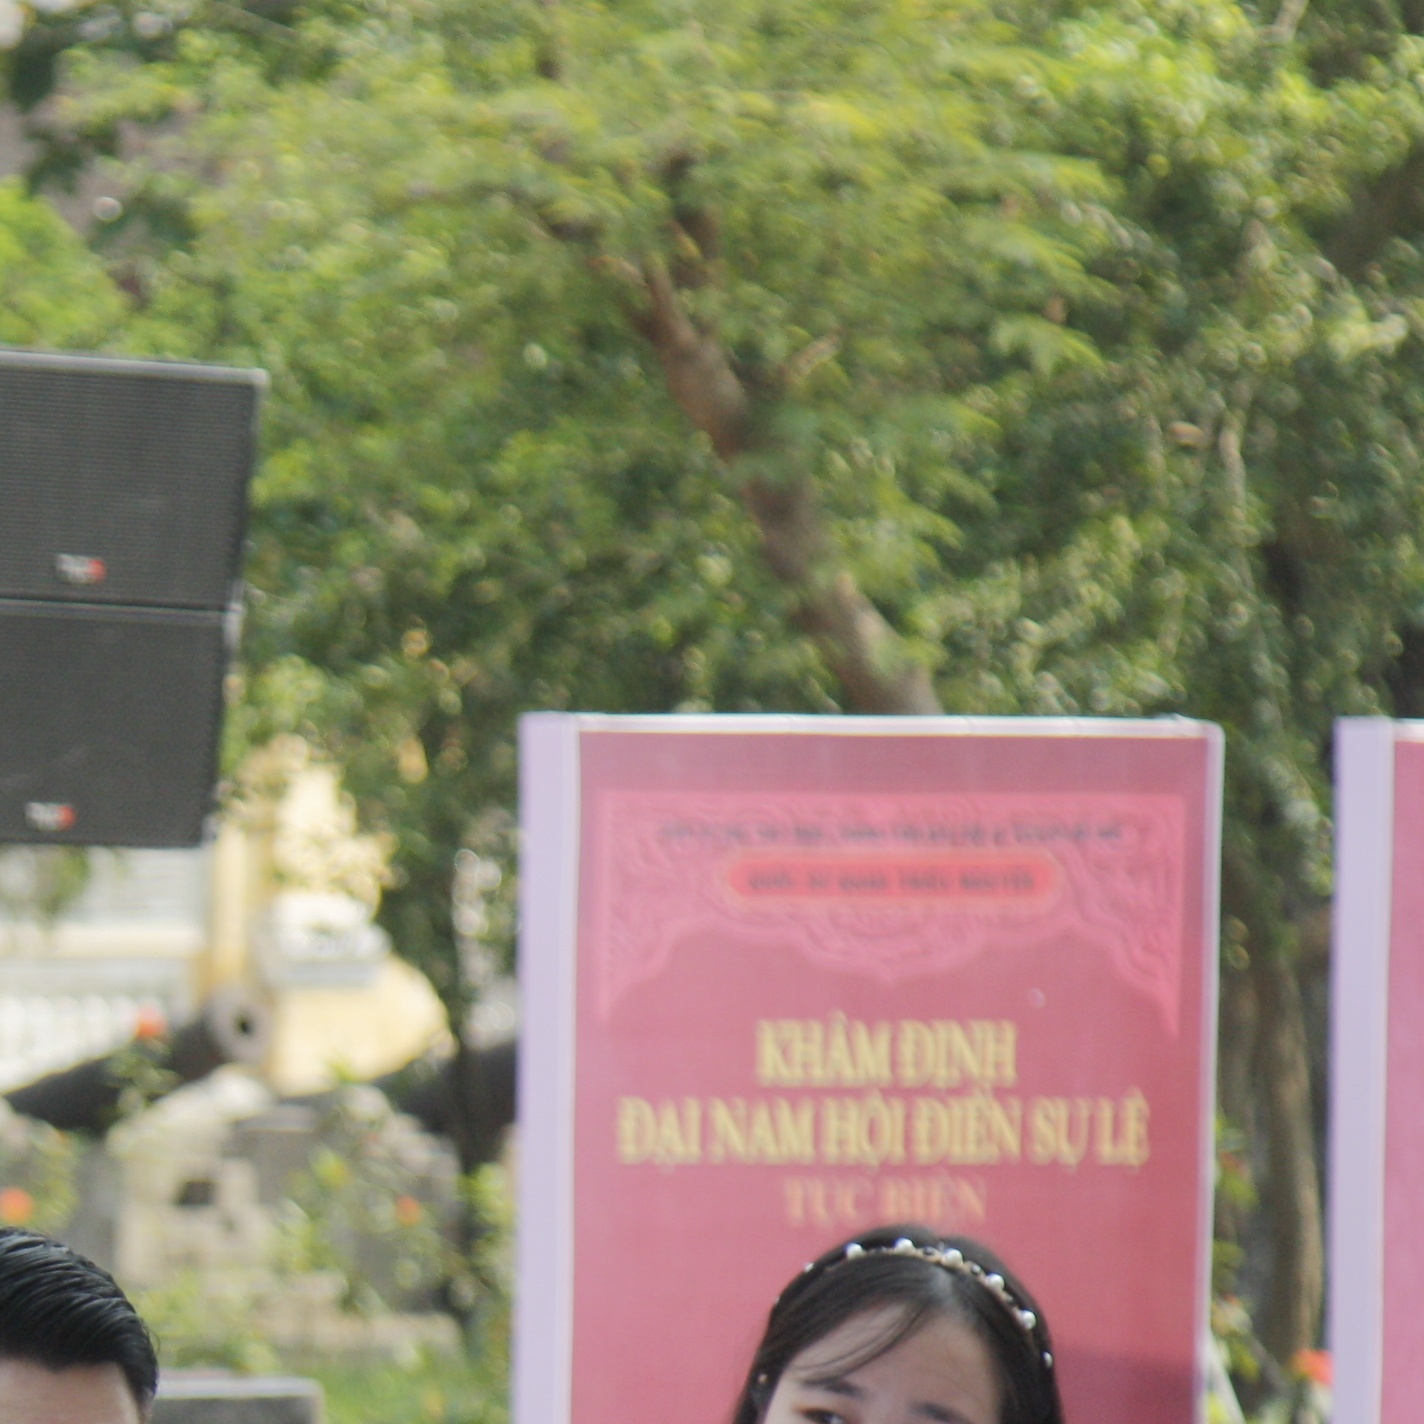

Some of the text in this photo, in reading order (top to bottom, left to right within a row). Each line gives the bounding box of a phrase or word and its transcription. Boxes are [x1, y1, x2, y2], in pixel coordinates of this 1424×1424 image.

[897, 1019, 1017, 1091] ĐỊNH
[617, 1097, 702, 1173] ĐẠI
[708, 1097, 815, 1165] NAM
[823, 1091, 906, 1172] HỘI
[1029, 1096, 1093, 1172] SỰ
